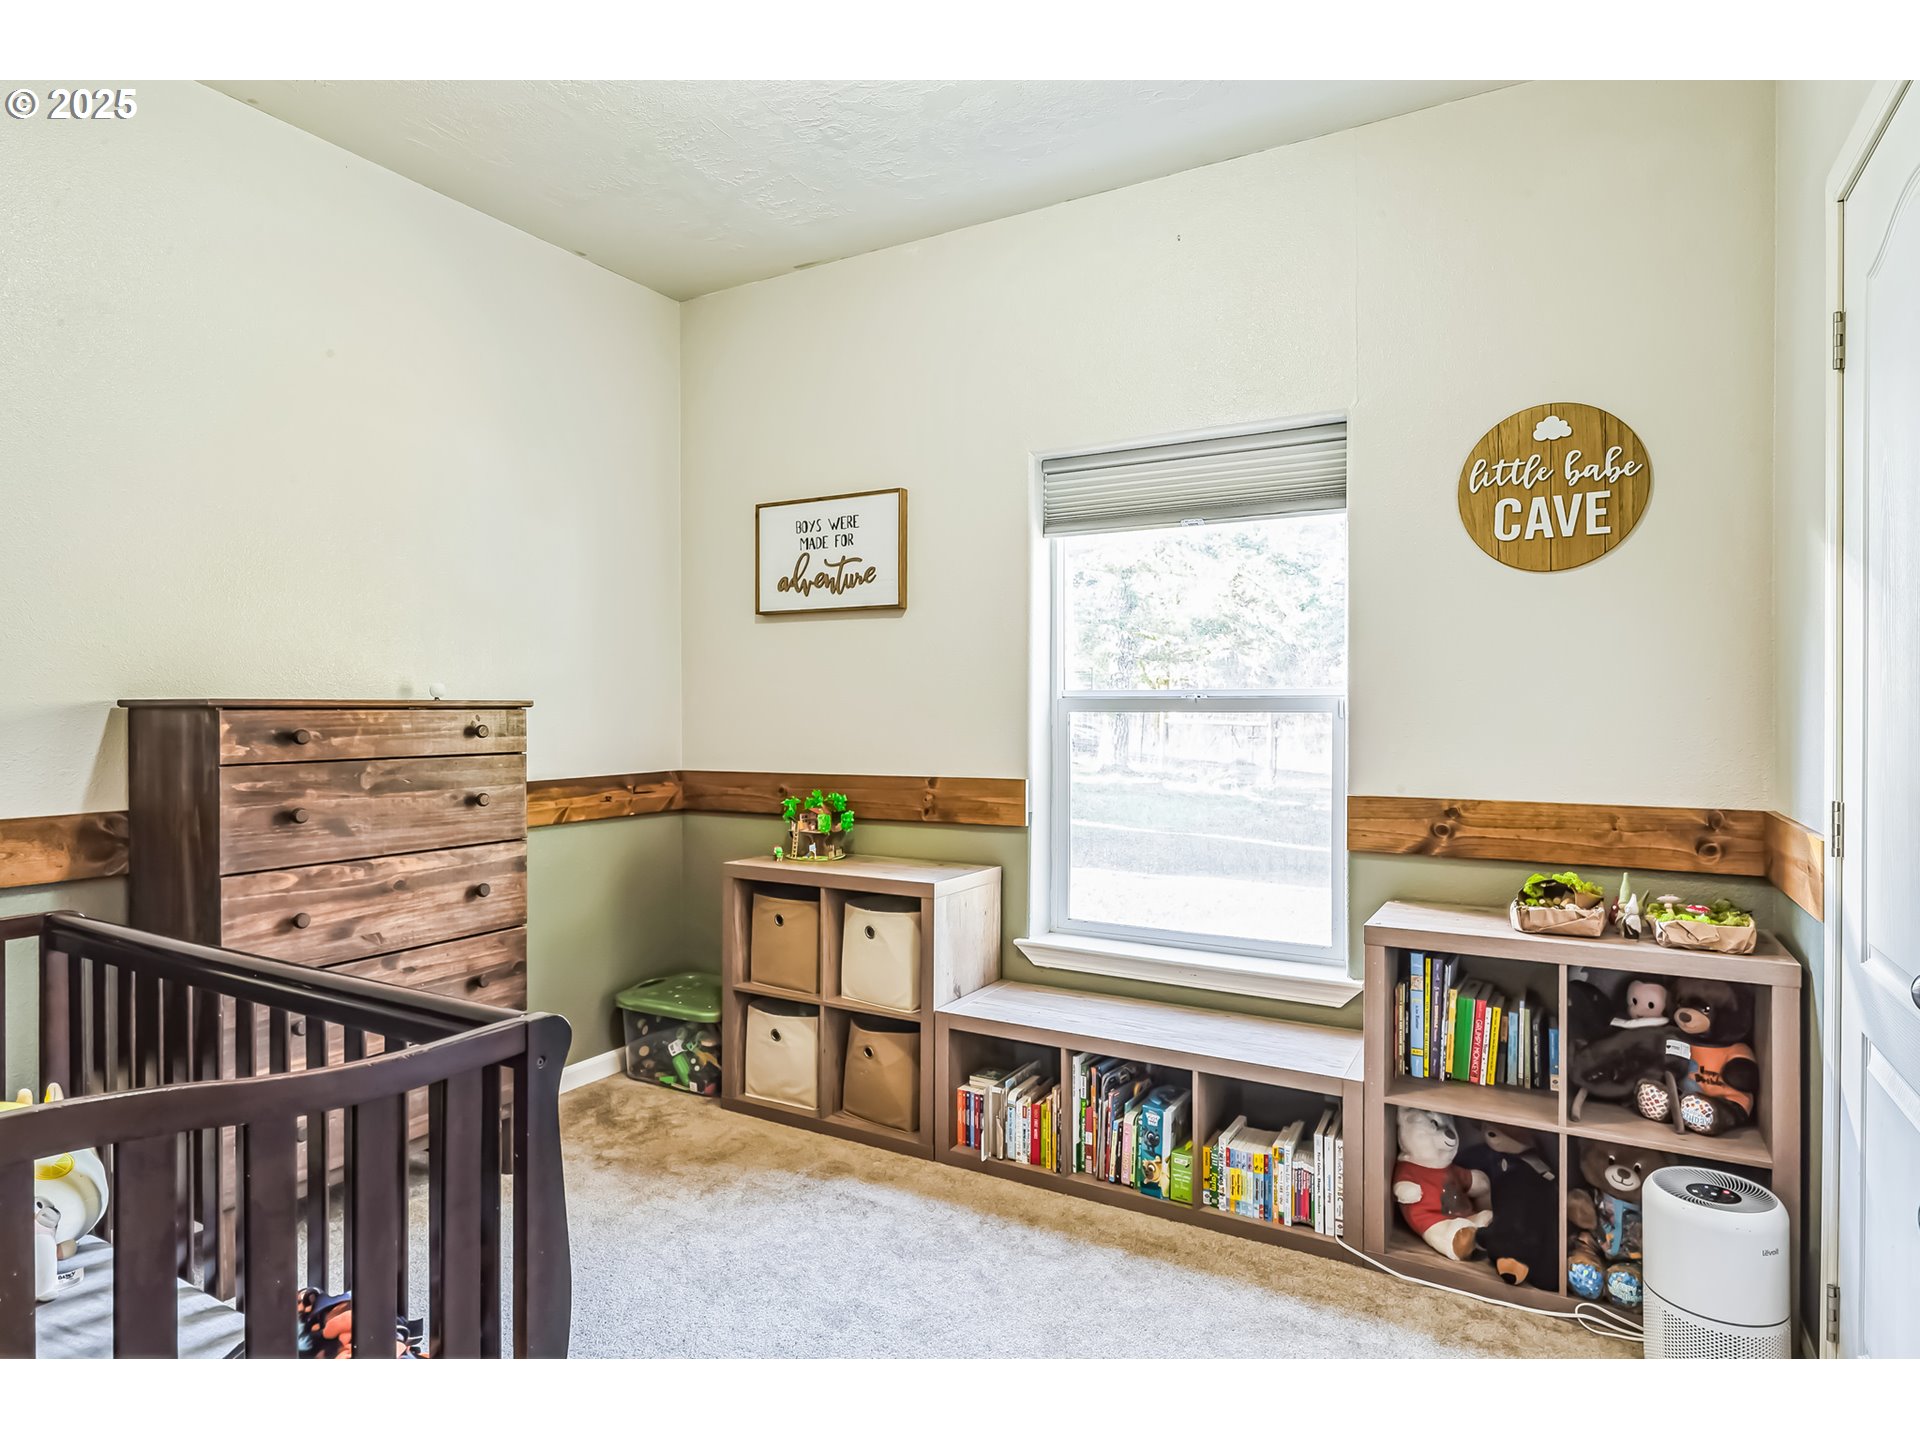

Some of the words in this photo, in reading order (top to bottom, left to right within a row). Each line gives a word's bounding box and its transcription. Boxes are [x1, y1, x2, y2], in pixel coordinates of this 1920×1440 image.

[1468, 453, 1555, 495] little
[1564, 445, 1644, 487] babe
[795, 518, 822, 535] BOYS
[828, 514, 860, 531] WERE
[1493, 489, 1612, 542] CAVE
[799, 535, 829, 551] MADE
[834, 532, 854, 548] FOR
[776, 552, 877, 598] adventure
